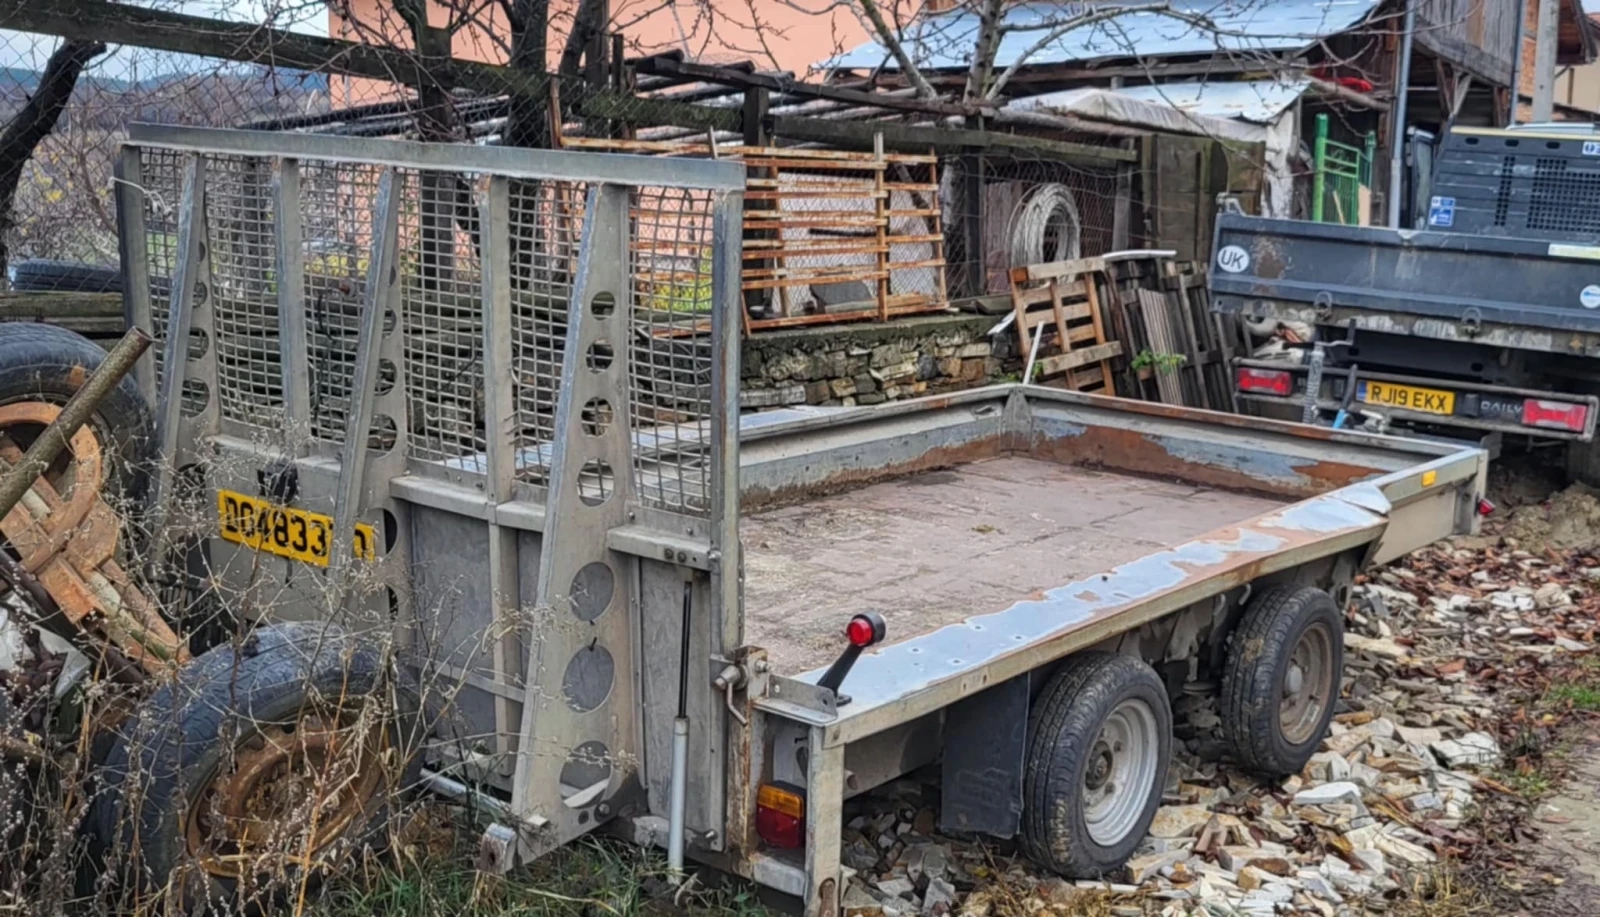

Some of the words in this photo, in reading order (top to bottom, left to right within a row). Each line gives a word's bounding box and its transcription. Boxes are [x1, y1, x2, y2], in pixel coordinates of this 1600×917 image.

[1220, 249, 1245, 270] UK
[1371, 384, 1409, 406] RJ19
[1412, 391, 1447, 411] EKX
